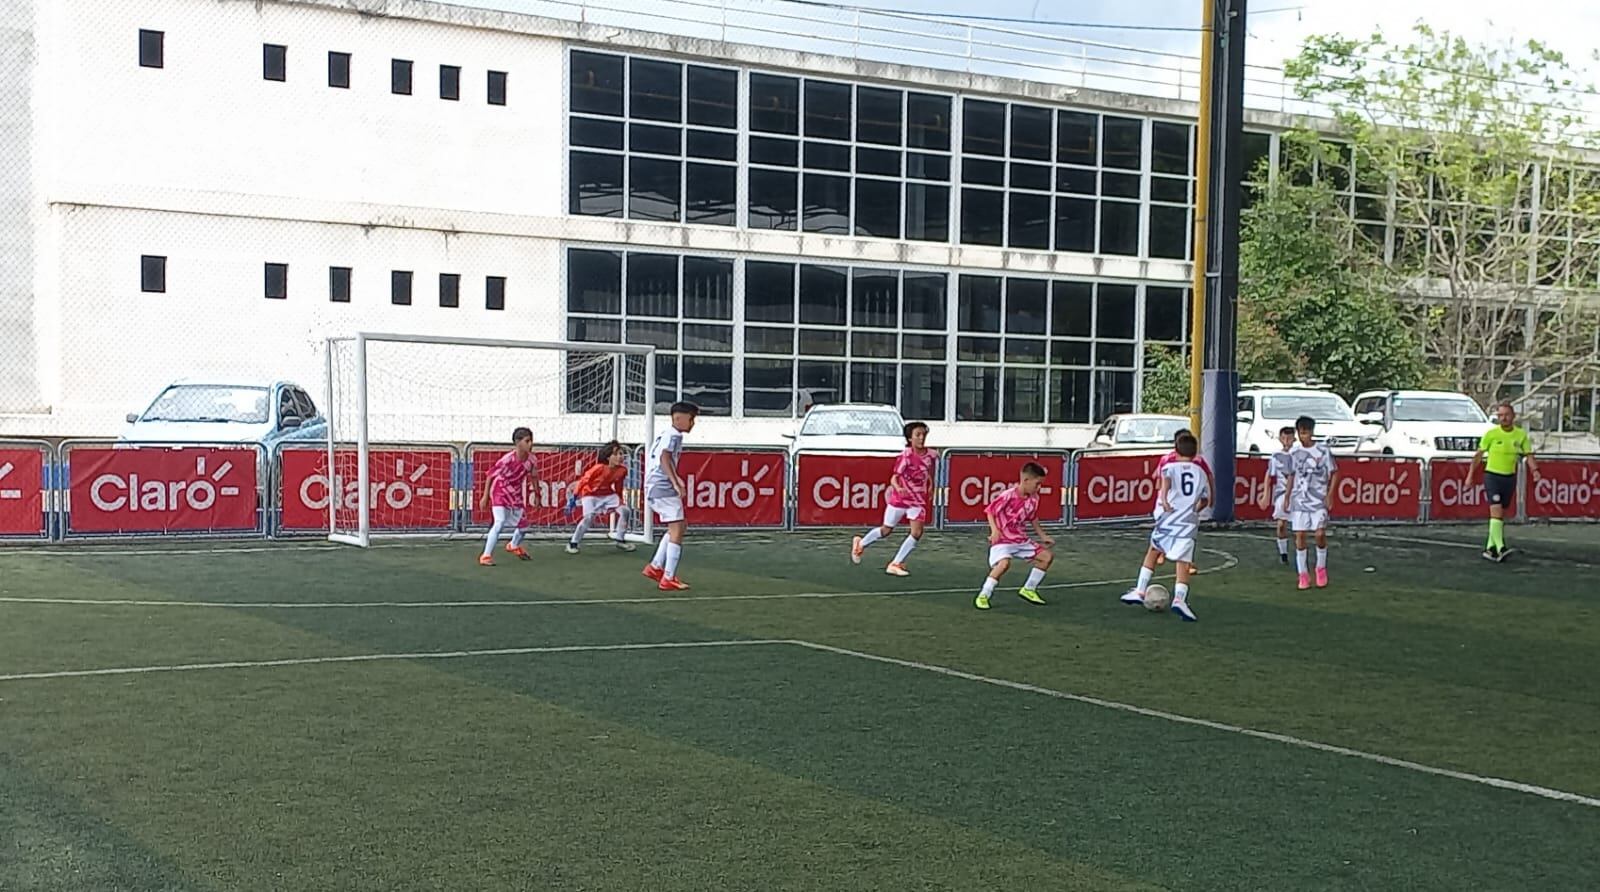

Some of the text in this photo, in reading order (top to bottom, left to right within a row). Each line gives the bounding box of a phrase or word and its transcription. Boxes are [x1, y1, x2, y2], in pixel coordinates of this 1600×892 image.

[90, 473, 216, 512] Claro
[687, 474, 755, 508] laro
[961, 476, 1019, 506] Cla
[1088, 476, 1154, 503] Claro
[1181, 472, 1194, 497] 6
[1338, 478, 1399, 505] Claro
[1440, 479, 1489, 506] Clar
[1535, 479, 1592, 505] Claro
